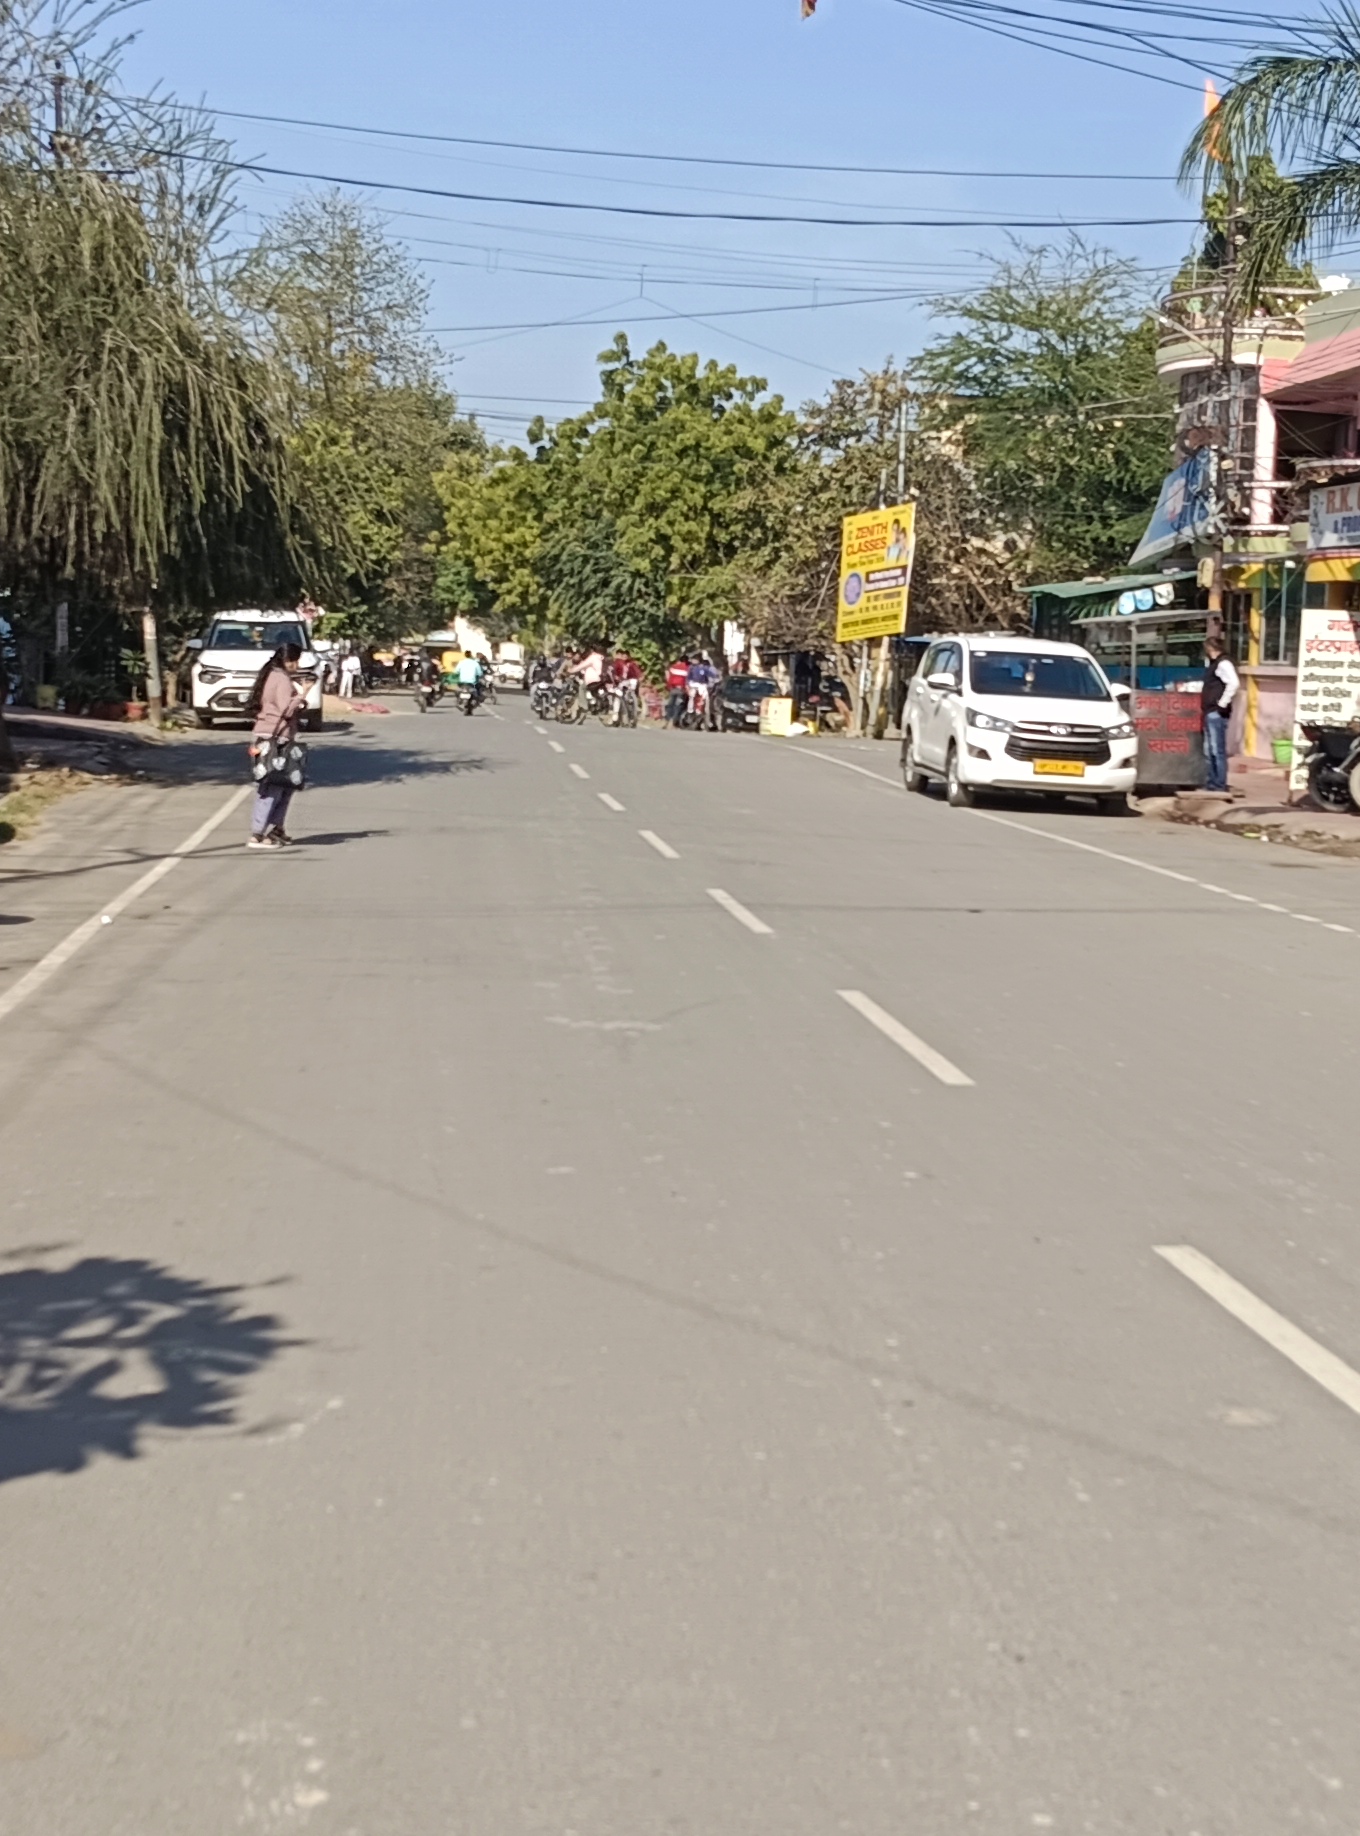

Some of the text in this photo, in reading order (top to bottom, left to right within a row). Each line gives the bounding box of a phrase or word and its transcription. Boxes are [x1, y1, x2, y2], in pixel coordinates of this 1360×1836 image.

[1327, 487, 1353, 515] R.K.
[855, 521, 889, 540] ZENITH
[846, 536, 888, 557] CLASSES
